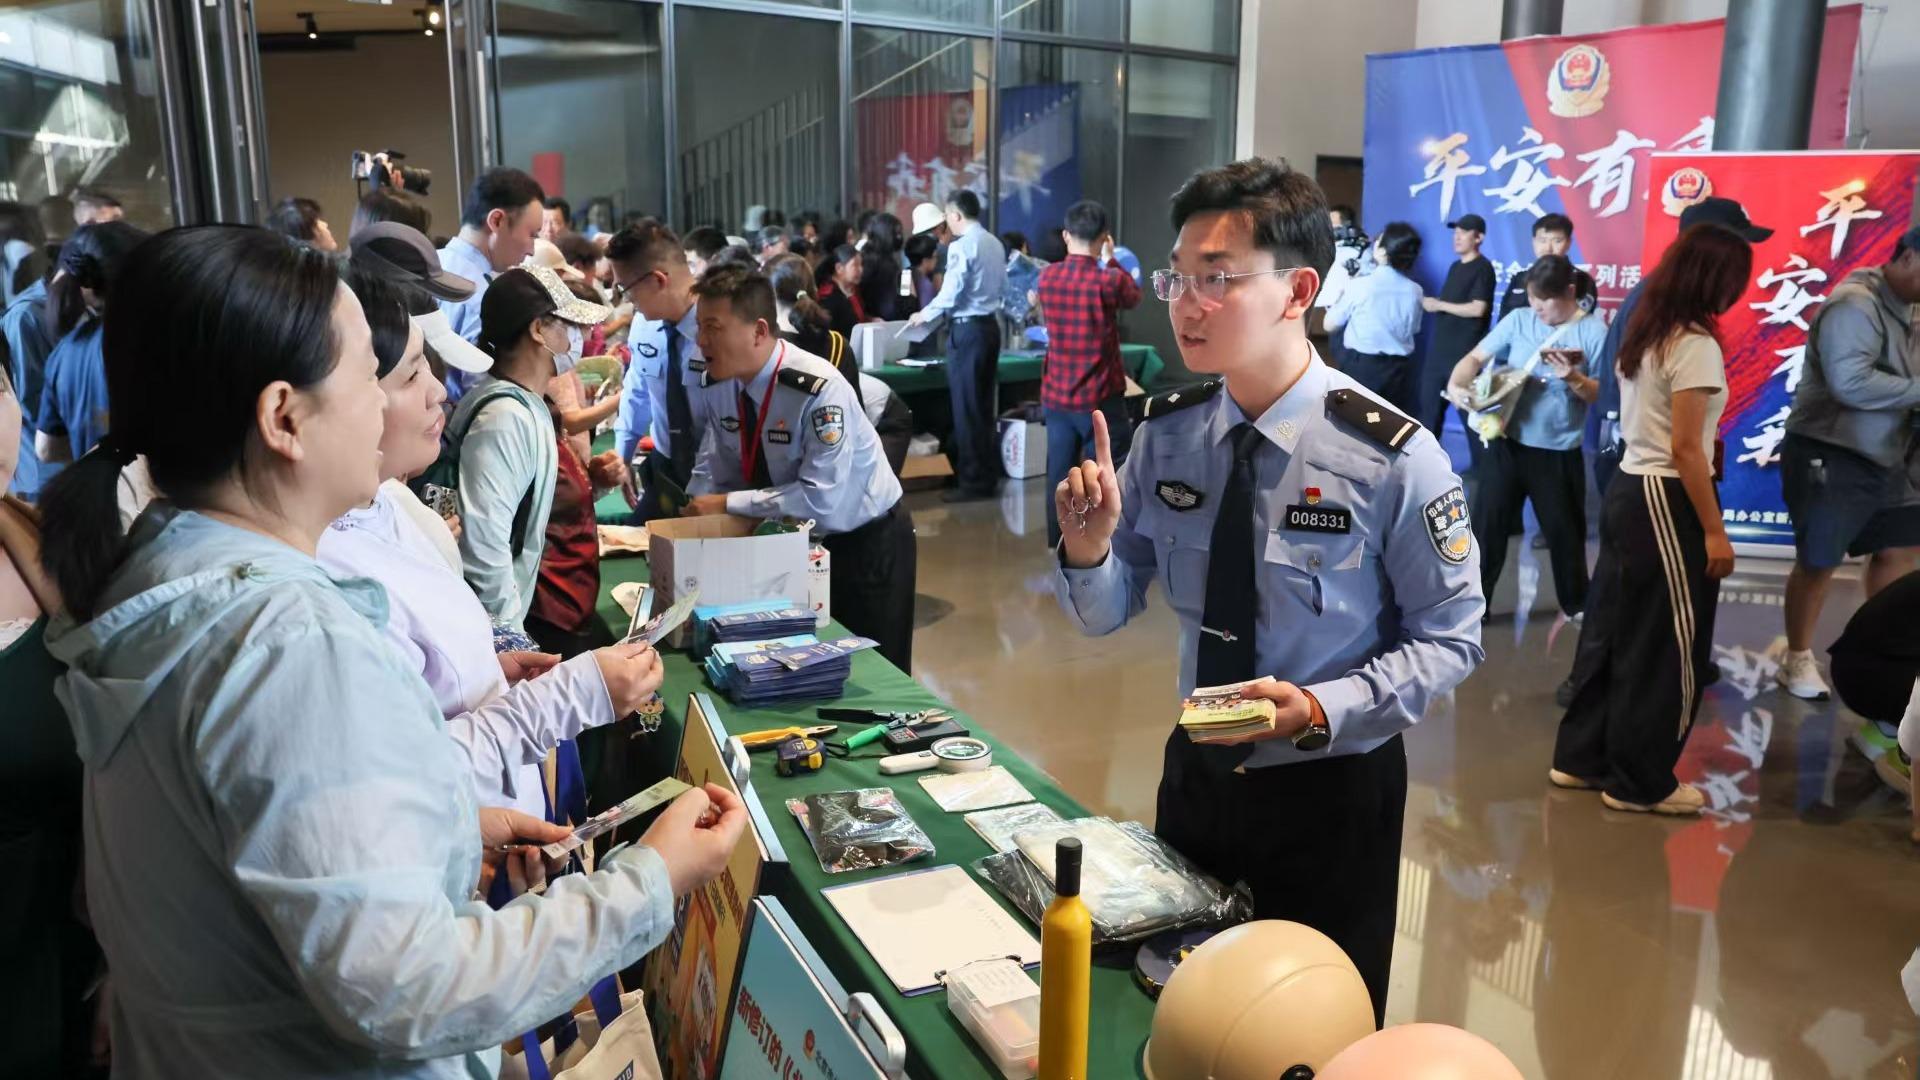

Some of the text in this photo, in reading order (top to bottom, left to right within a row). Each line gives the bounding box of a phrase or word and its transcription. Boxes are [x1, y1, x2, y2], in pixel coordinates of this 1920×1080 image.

[1291, 511, 1346, 529] 008331
[1722, 508, 1792, 525] 局办公室新
